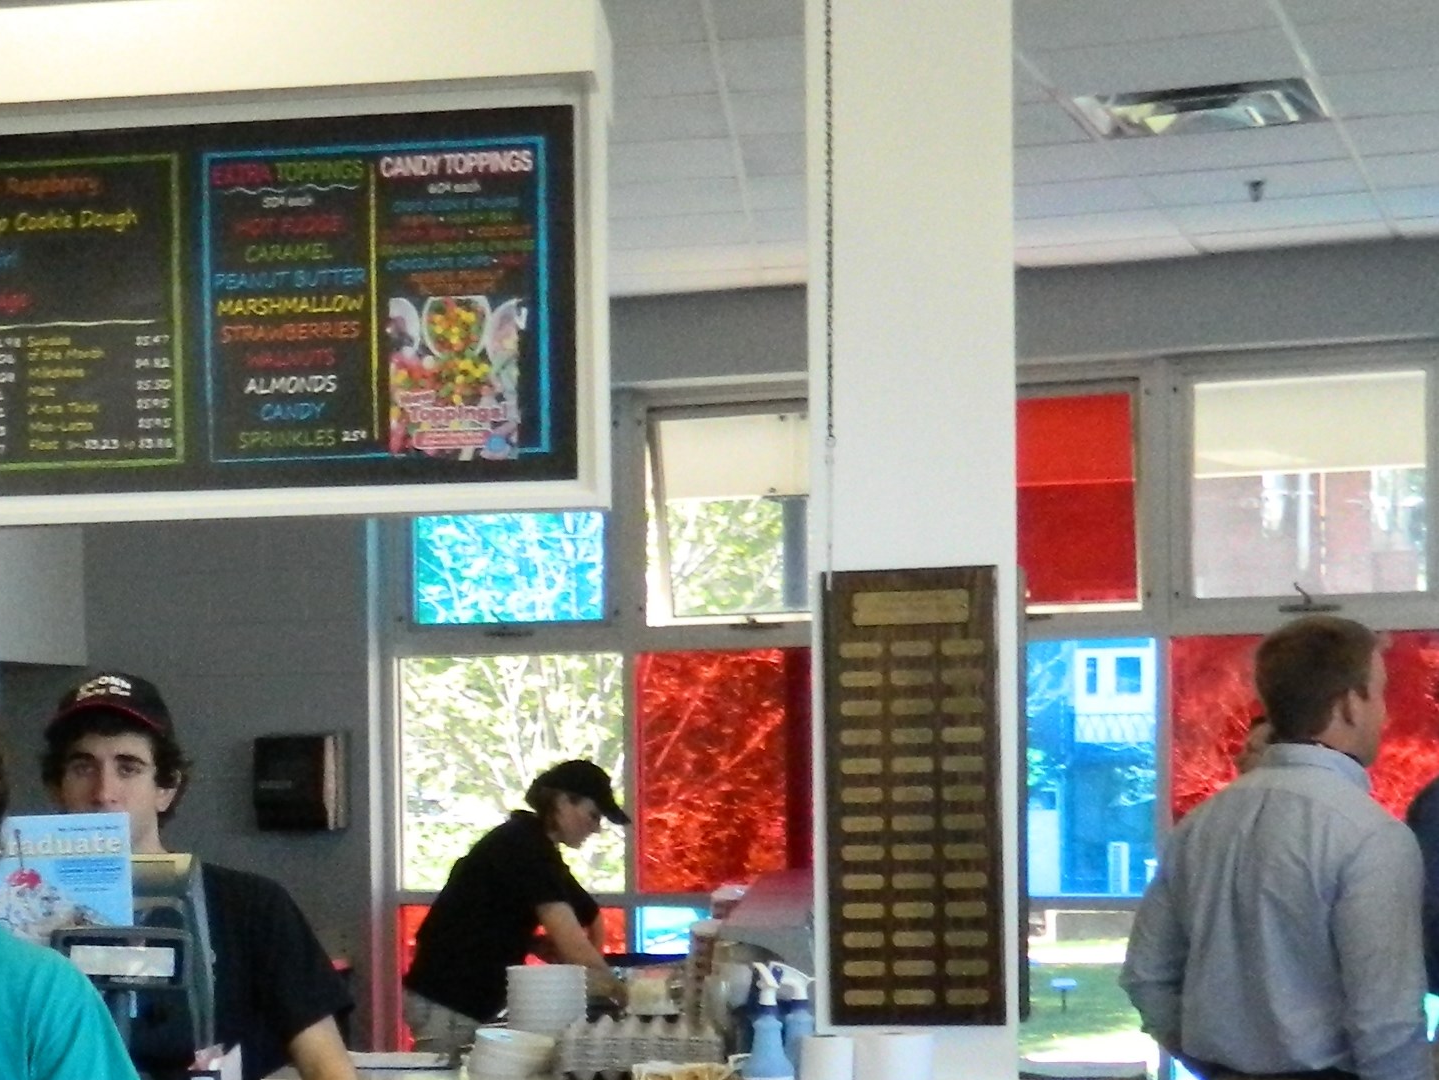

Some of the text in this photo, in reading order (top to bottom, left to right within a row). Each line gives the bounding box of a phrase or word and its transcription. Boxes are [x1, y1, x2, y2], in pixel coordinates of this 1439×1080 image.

[274, 159, 365, 183] TOPPINGS
[380, 149, 534, 178] CANDY TOPPINGS
[14, 208, 74, 232] Cookie
[79, 204, 139, 233] Dough
[244, 242, 334, 263] CARAMEL
[212, 266, 366, 291] PEANUT BUTTER
[216, 294, 365, 317] MARSHMALLOW
[220, 320, 362, 344] STRAWBERRIES
[243, 374, 338, 396] ALMONDS
[259, 401, 327, 423] CANDY
[238, 428, 337, 450] SPRINKLES
